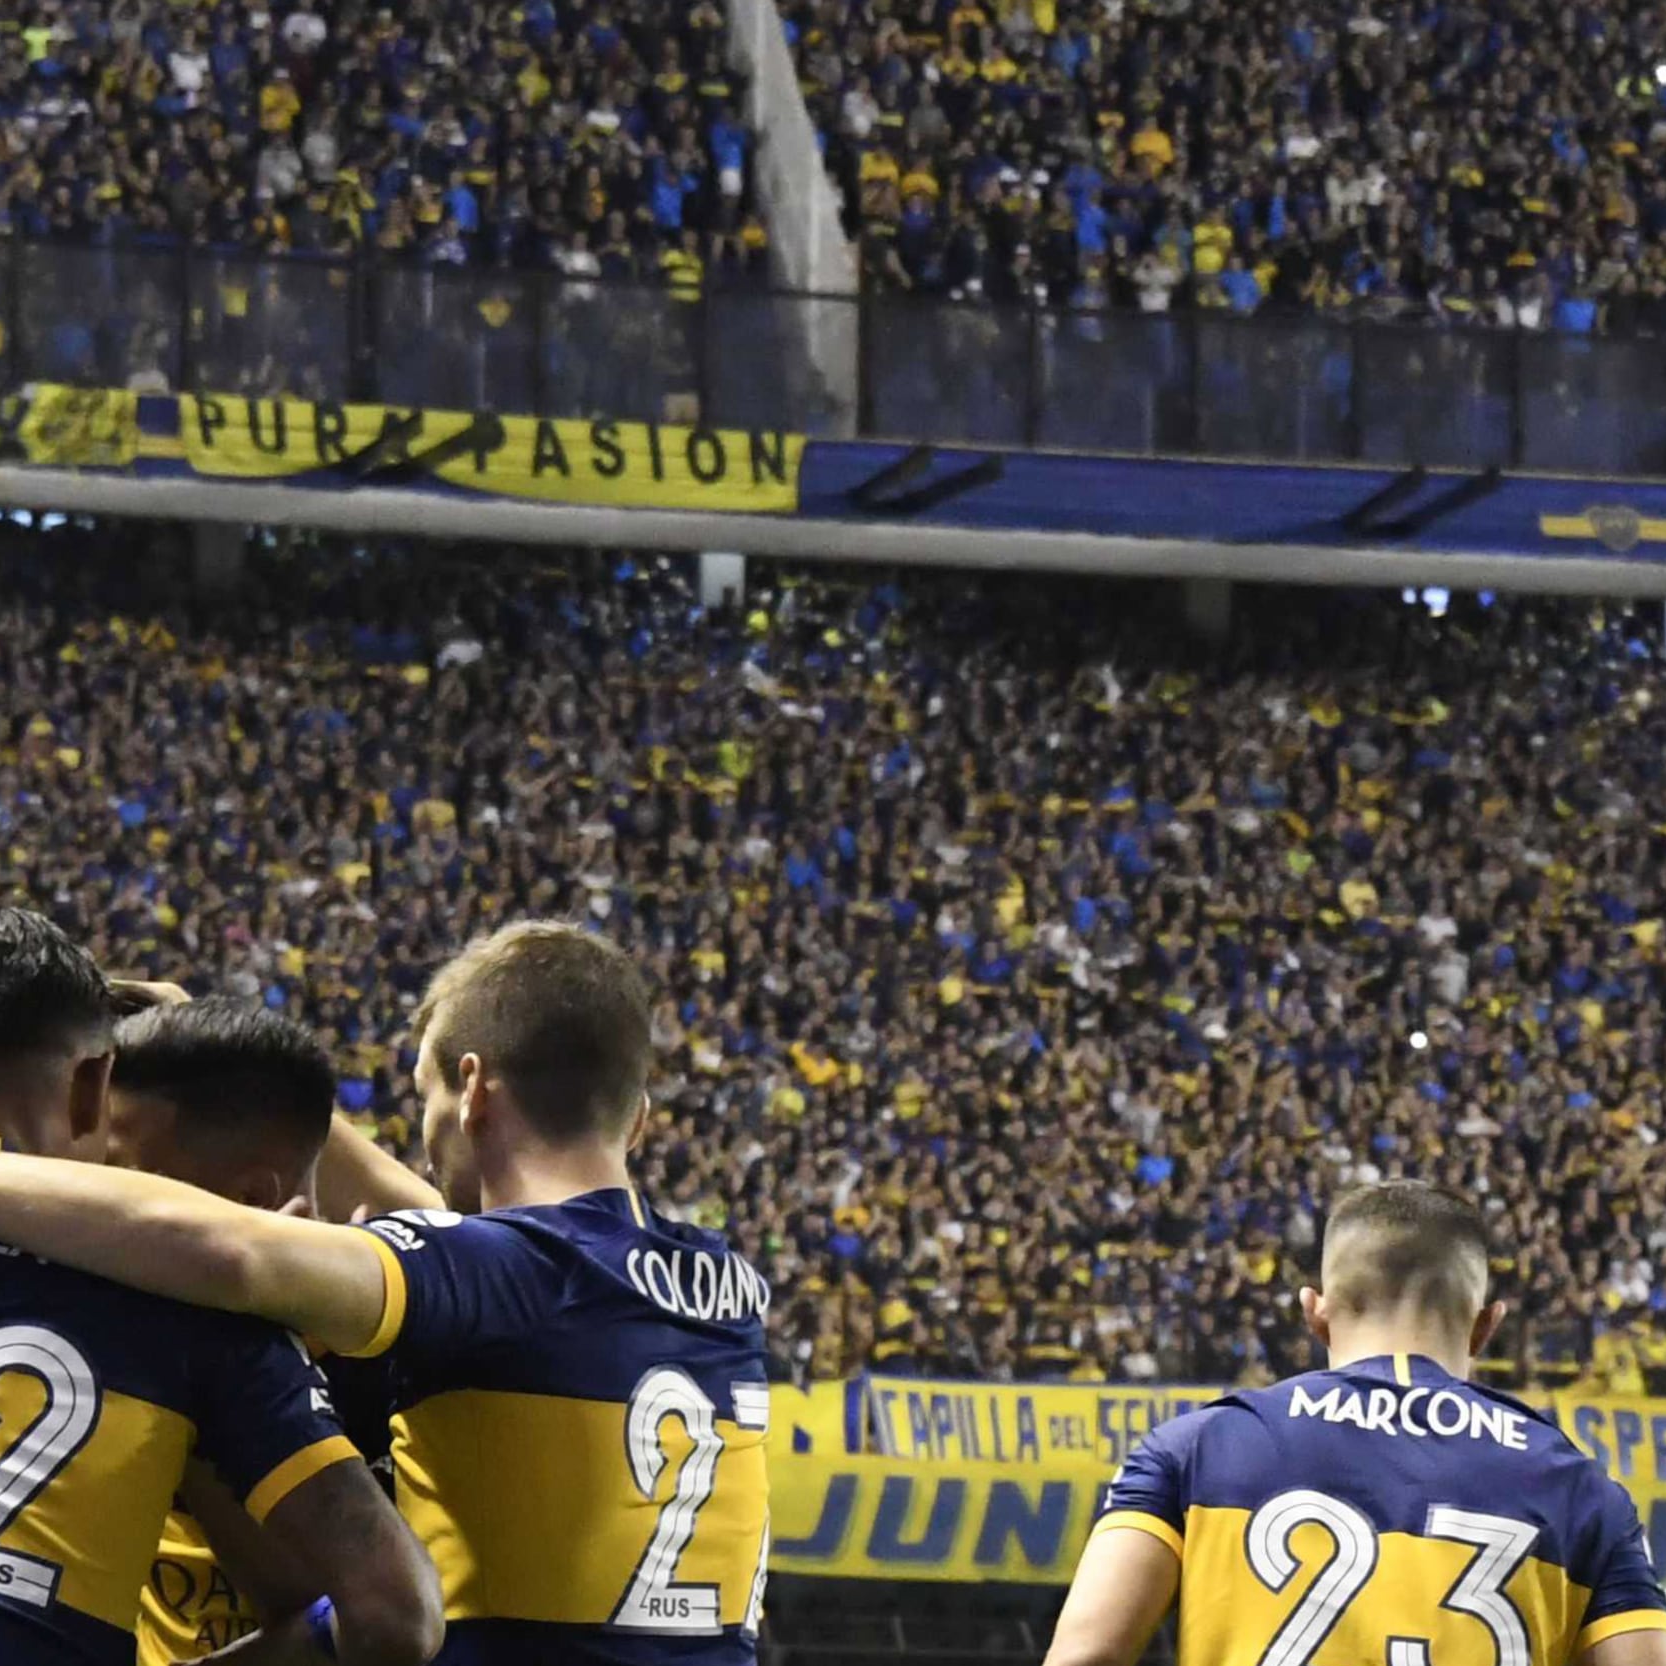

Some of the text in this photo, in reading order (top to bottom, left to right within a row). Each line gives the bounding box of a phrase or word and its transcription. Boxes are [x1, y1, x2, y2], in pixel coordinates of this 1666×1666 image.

[1049, 1414, 1093, 1450] DEL
[1288, 1385, 1529, 1451] MARCONE
[647, 1597, 691, 1619] RUS
